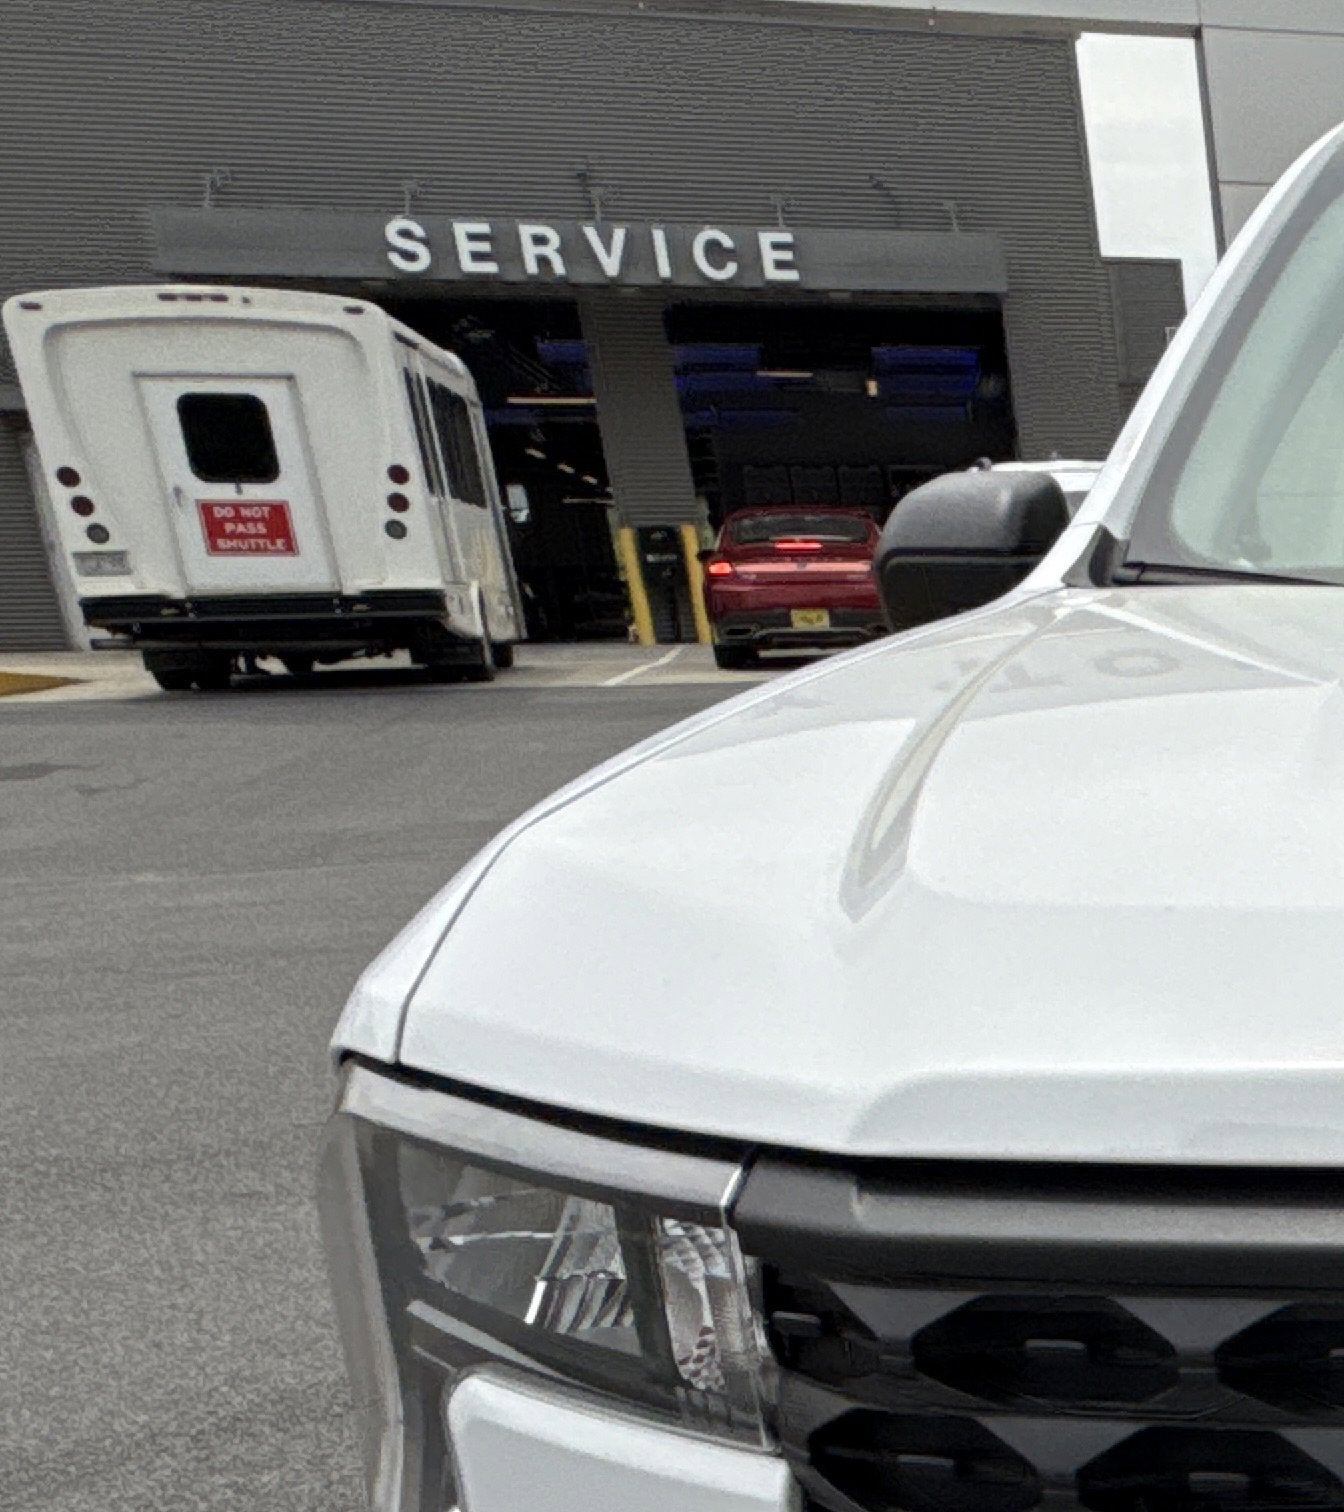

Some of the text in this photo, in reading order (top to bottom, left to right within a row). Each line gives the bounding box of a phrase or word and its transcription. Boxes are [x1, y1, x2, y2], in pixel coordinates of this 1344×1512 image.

[384, 218, 800, 282] SERVICE
[212, 506, 270, 519] DO NOT
[223, 522, 268, 534] PASS
[216, 538, 287, 551] SHUTTLE
